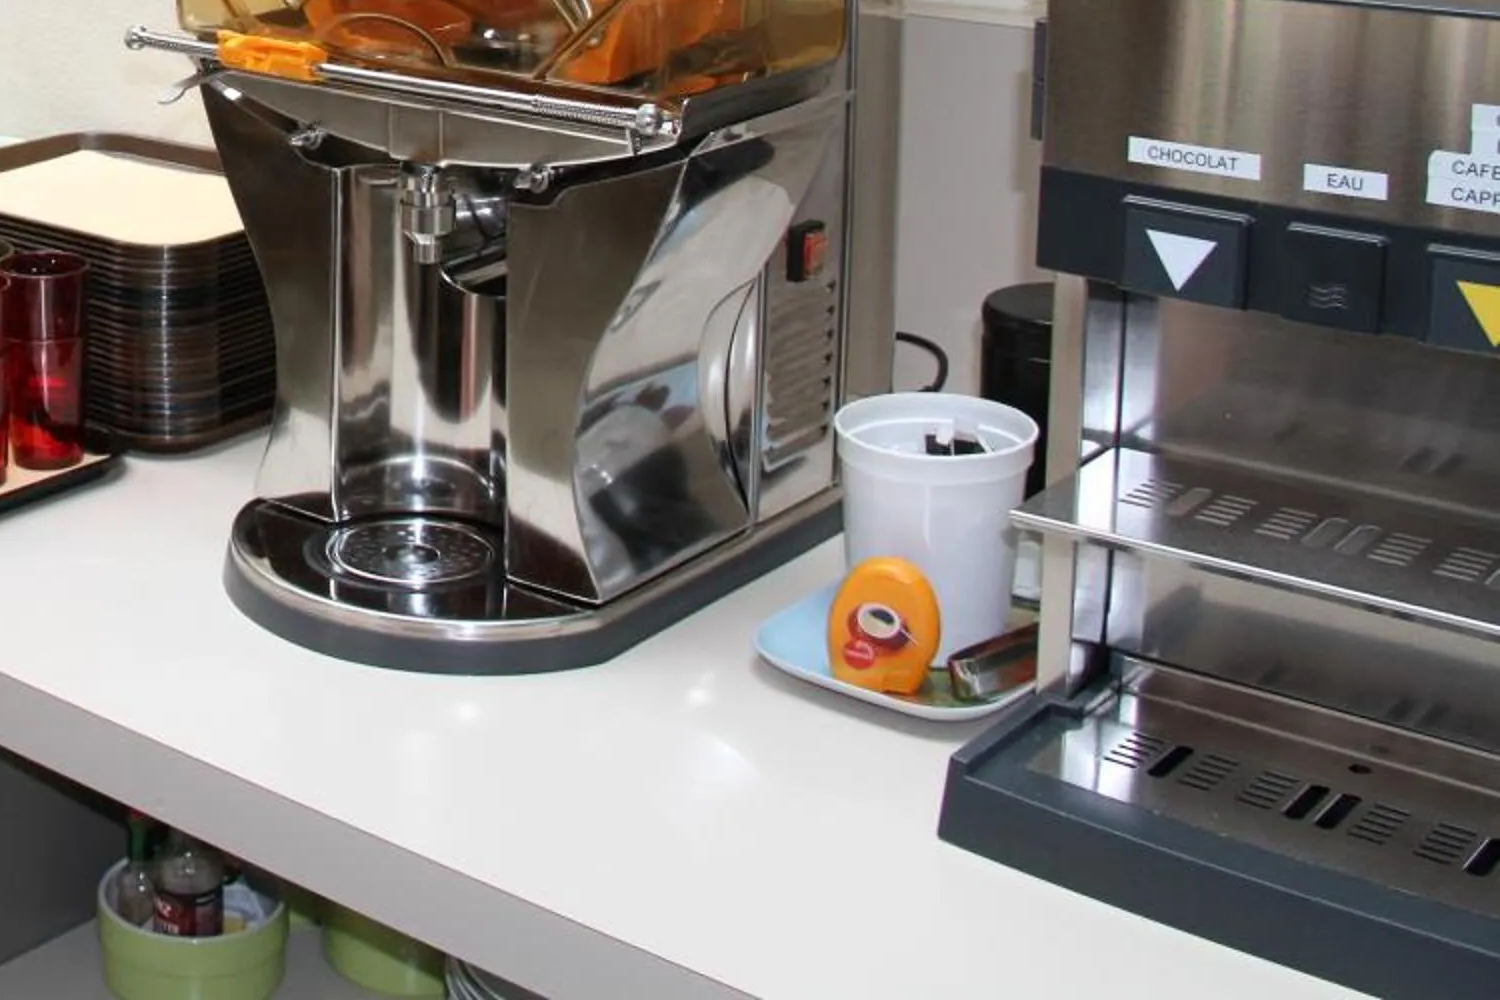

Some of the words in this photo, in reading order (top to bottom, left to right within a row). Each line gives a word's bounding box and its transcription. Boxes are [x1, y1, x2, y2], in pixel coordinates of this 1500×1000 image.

[1147, 145, 1239, 171] CHOCOLAT
[1451, 160, 1500, 181] CAFE
[1327, 173, 1365, 192] EAU
